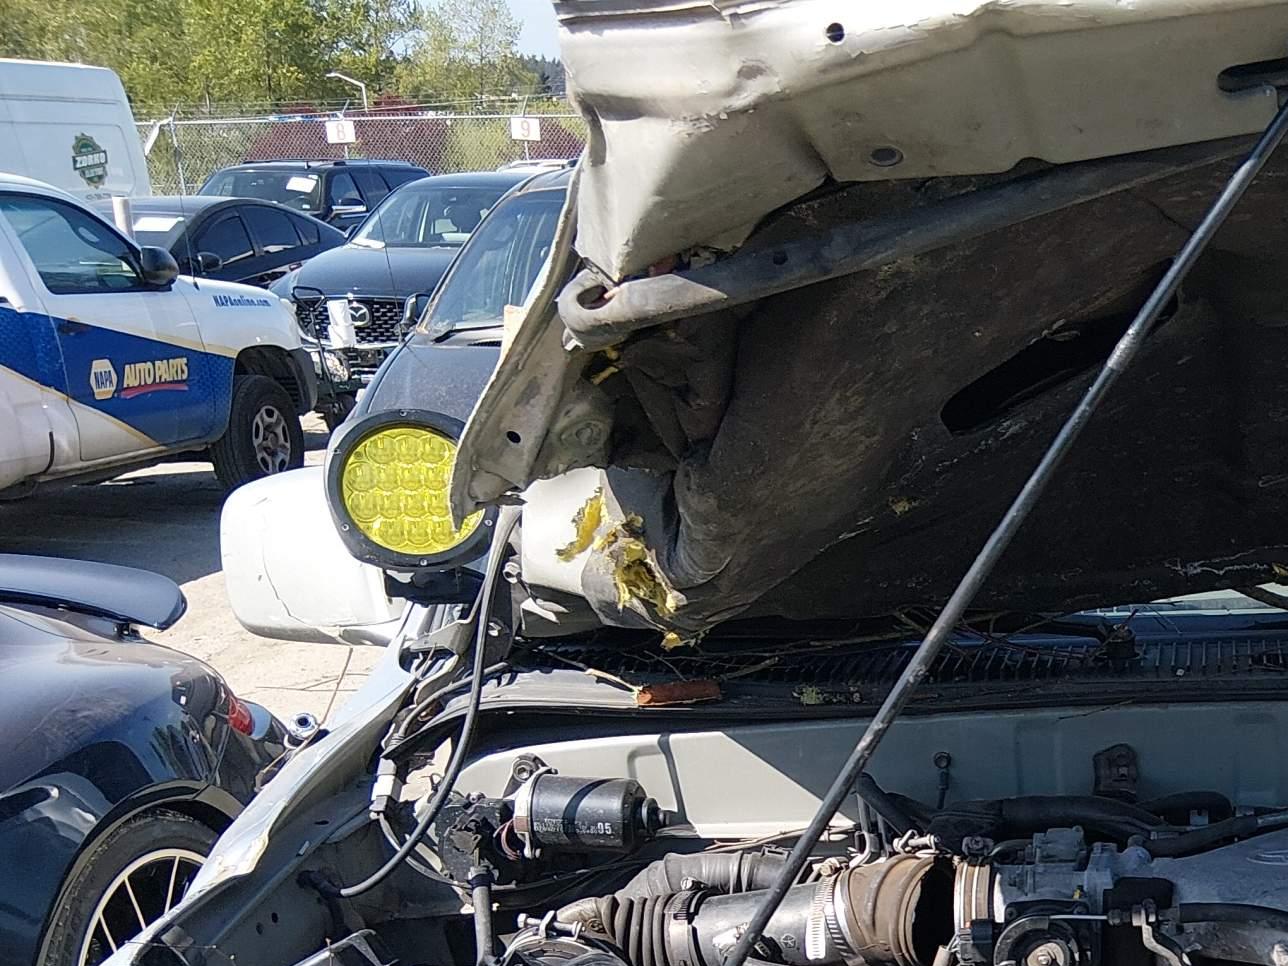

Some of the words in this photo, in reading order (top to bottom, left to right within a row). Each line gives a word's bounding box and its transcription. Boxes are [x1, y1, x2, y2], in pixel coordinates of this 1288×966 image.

[521, 120, 531, 138] 9
[212, 295, 272, 307] NAPAonline.com
[93, 369, 115, 390] NAPA
[123, 361, 154, 388] AUTO
[154, 357, 188, 384] PARTS
